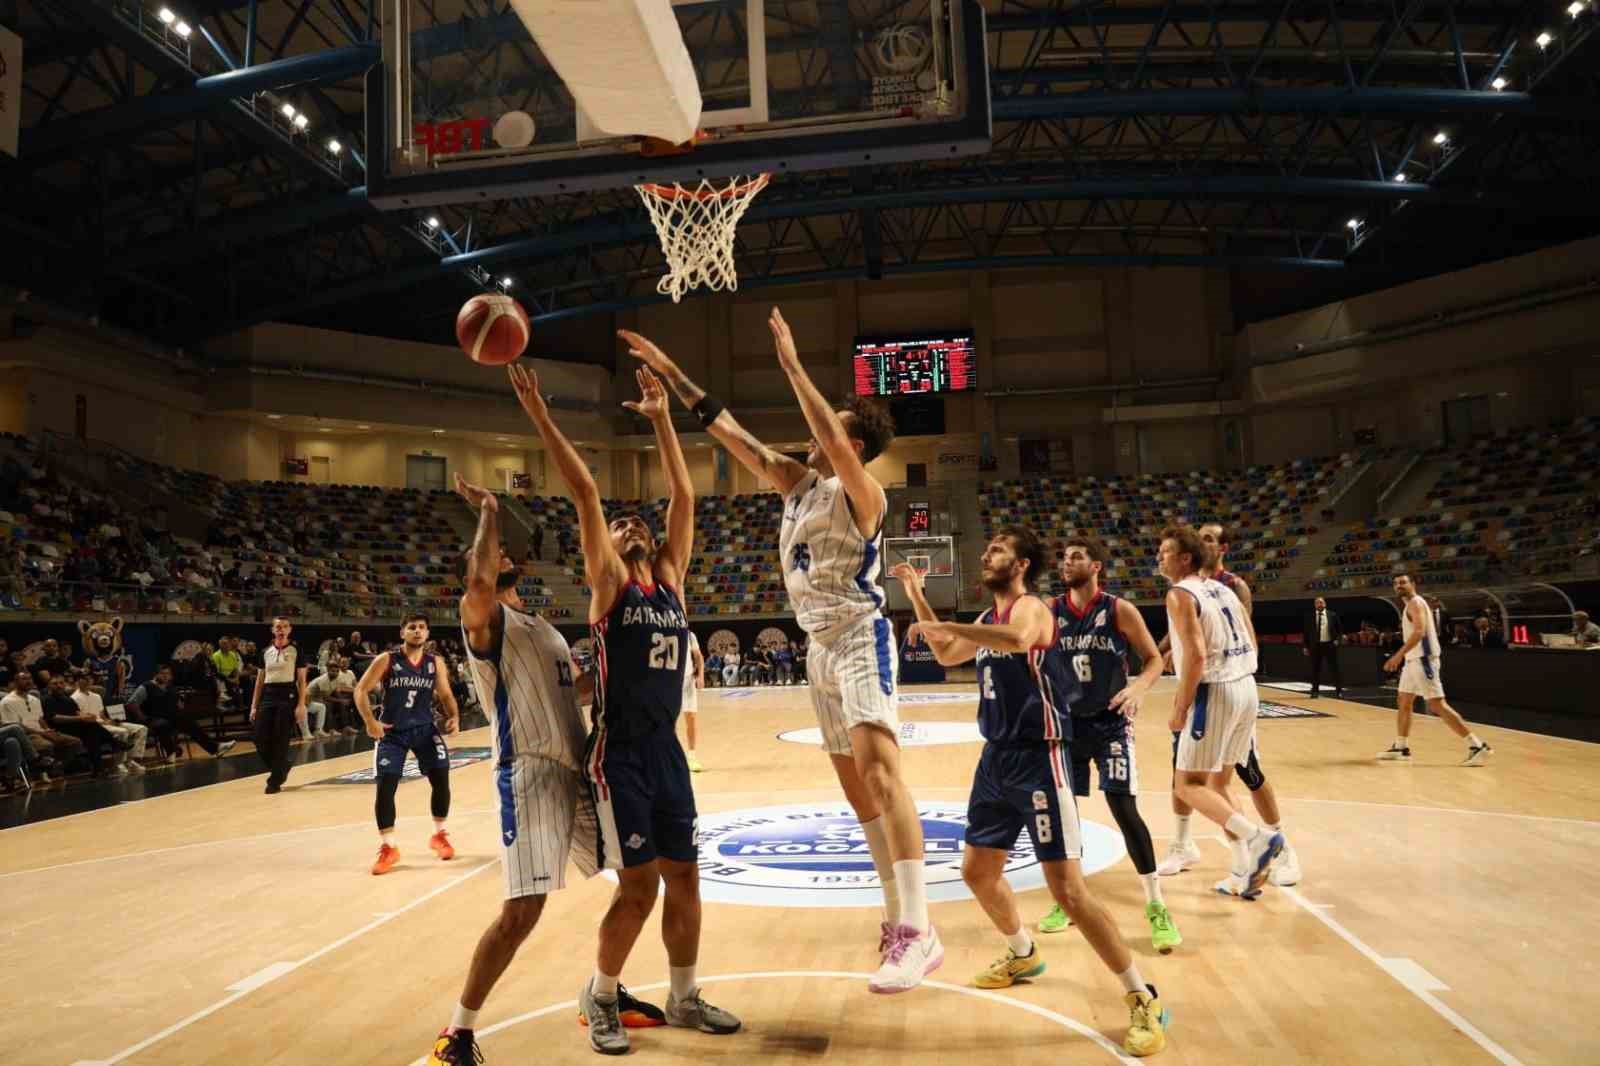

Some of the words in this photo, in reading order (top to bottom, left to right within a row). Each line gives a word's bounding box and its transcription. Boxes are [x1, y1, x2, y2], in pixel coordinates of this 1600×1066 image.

[910, 516, 928, 529] 24
[1513, 624, 1528, 644] 11
[649, 632, 679, 670] 20
[405, 690, 418, 708] 5
[436, 744, 447, 760] 5
[1106, 758, 1128, 780] 16
[1036, 813, 1053, 843] 8
